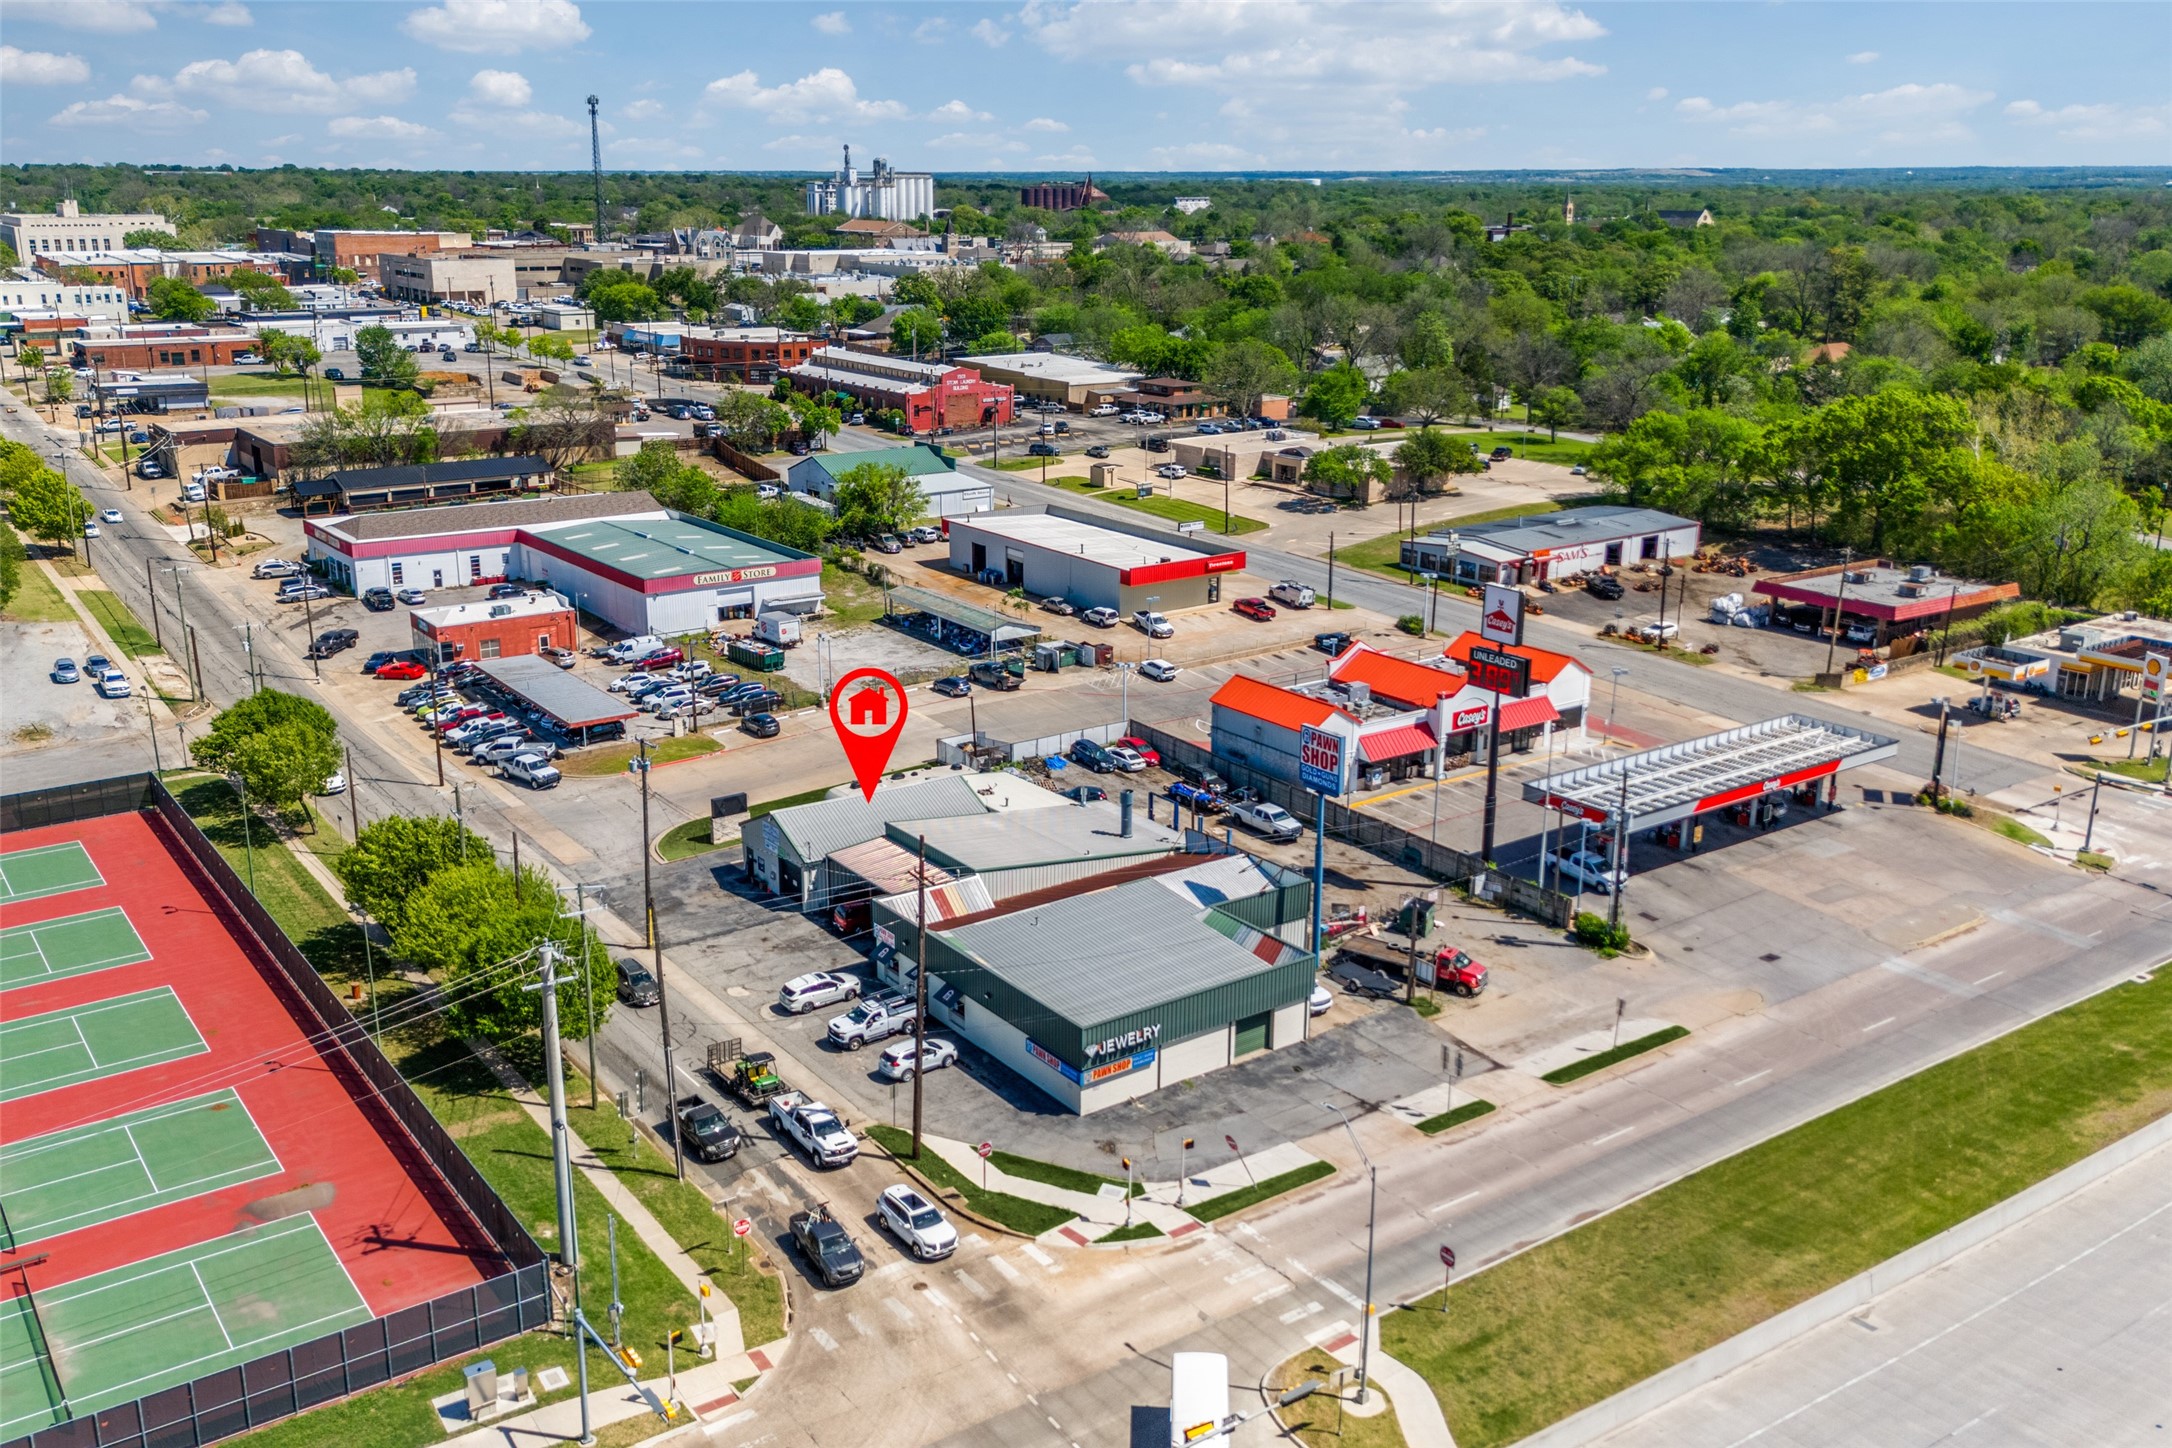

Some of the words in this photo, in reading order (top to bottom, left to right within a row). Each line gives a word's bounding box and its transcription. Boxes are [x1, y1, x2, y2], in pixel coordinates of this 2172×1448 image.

[697, 573, 730, 584] FAMILY
[743, 568, 771, 578] STORE
[1487, 615, 1512, 630] Casey's
[1473, 650, 1517, 668] UNLEADED
[1457, 708, 1486, 726] Casey's
[1311, 731, 1339, 753] PAWN
[1302, 744, 1338, 772] SHOP
[1301, 764, 1317, 775] GOLD
[1321, 771, 1338, 783] GUNS
[1302, 772, 1336, 790] DIAMONDS
[1098, 1023, 1161, 1055] JEWELRY
[1093, 1065, 1112, 1079] PAWN
[1112, 1059, 1131, 1074] SHOP
